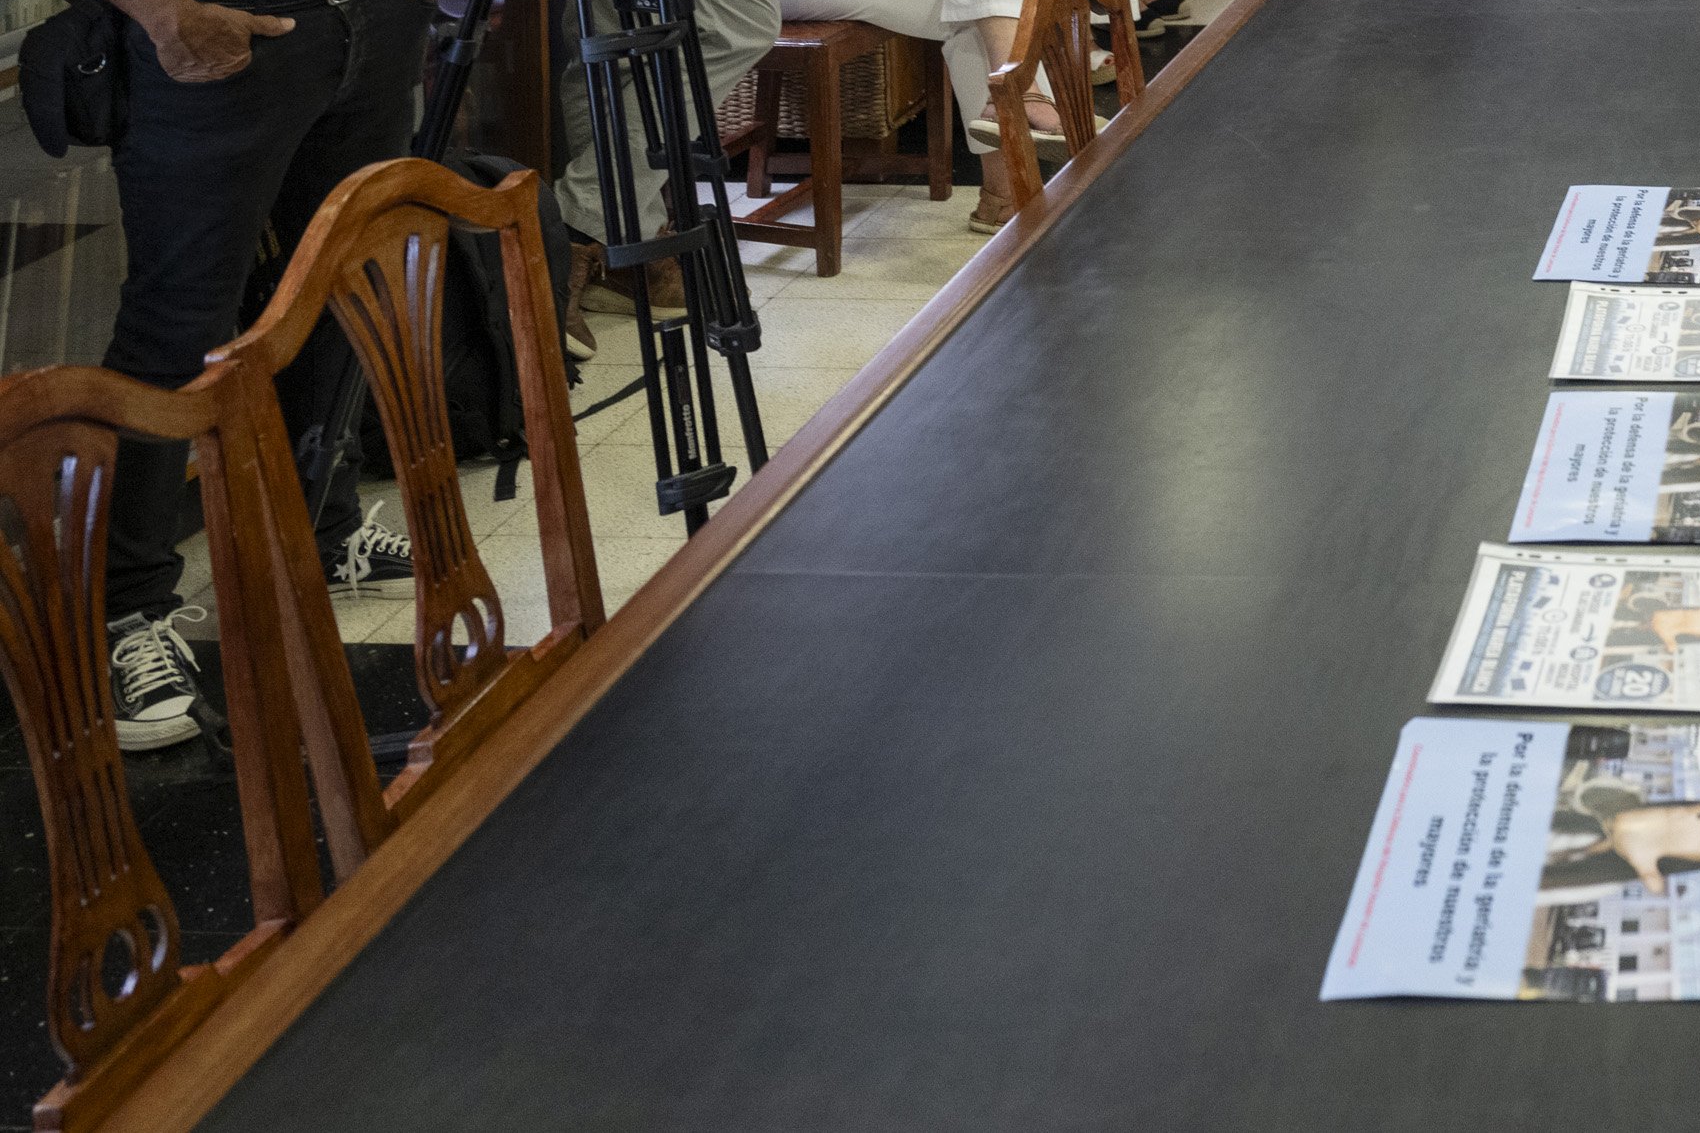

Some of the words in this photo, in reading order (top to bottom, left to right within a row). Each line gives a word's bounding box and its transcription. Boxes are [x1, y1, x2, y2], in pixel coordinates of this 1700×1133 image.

[1637, 189, 1648, 199] Por
[1606, 202, 1621, 234] protección
[1627, 206, 1642, 229] defensa
[1580, 219, 1596, 244] mayores
[1602, 234, 1612, 242] de
[1623, 230, 1634, 239] de
[1592, 242, 1608, 271] nuestros
[1608, 407, 1622, 415] la
[1635, 396, 1648, 412] Por
[1632, 413, 1646, 422] la
[1599, 417, 1617, 465] protección
[1624, 424, 1643, 459] defensa
[1567, 443, 1586, 483] mayores
[1594, 467, 1609, 478] de
[1621, 461, 1636, 473] de
[1619, 475, 1633, 484] la
[1583, 481, 1602, 525] nuestros
[1621, 668, 1653, 697] 20
[1514, 733, 1533, 758] Por
[1480, 752, 1498, 766] la
[1509, 763, 1526, 777] la
[1457, 770, 1489, 855] protección
[1494, 781, 1521, 843] defensa
[1413, 815, 1444, 888] mayores
[1488, 849, 1506, 868] de
[1450, 858, 1470, 879] de
[1484, 872, 1503, 890] la
[1429, 884, 1460, 963] nuestros
[1455, 975, 1475, 987] y
